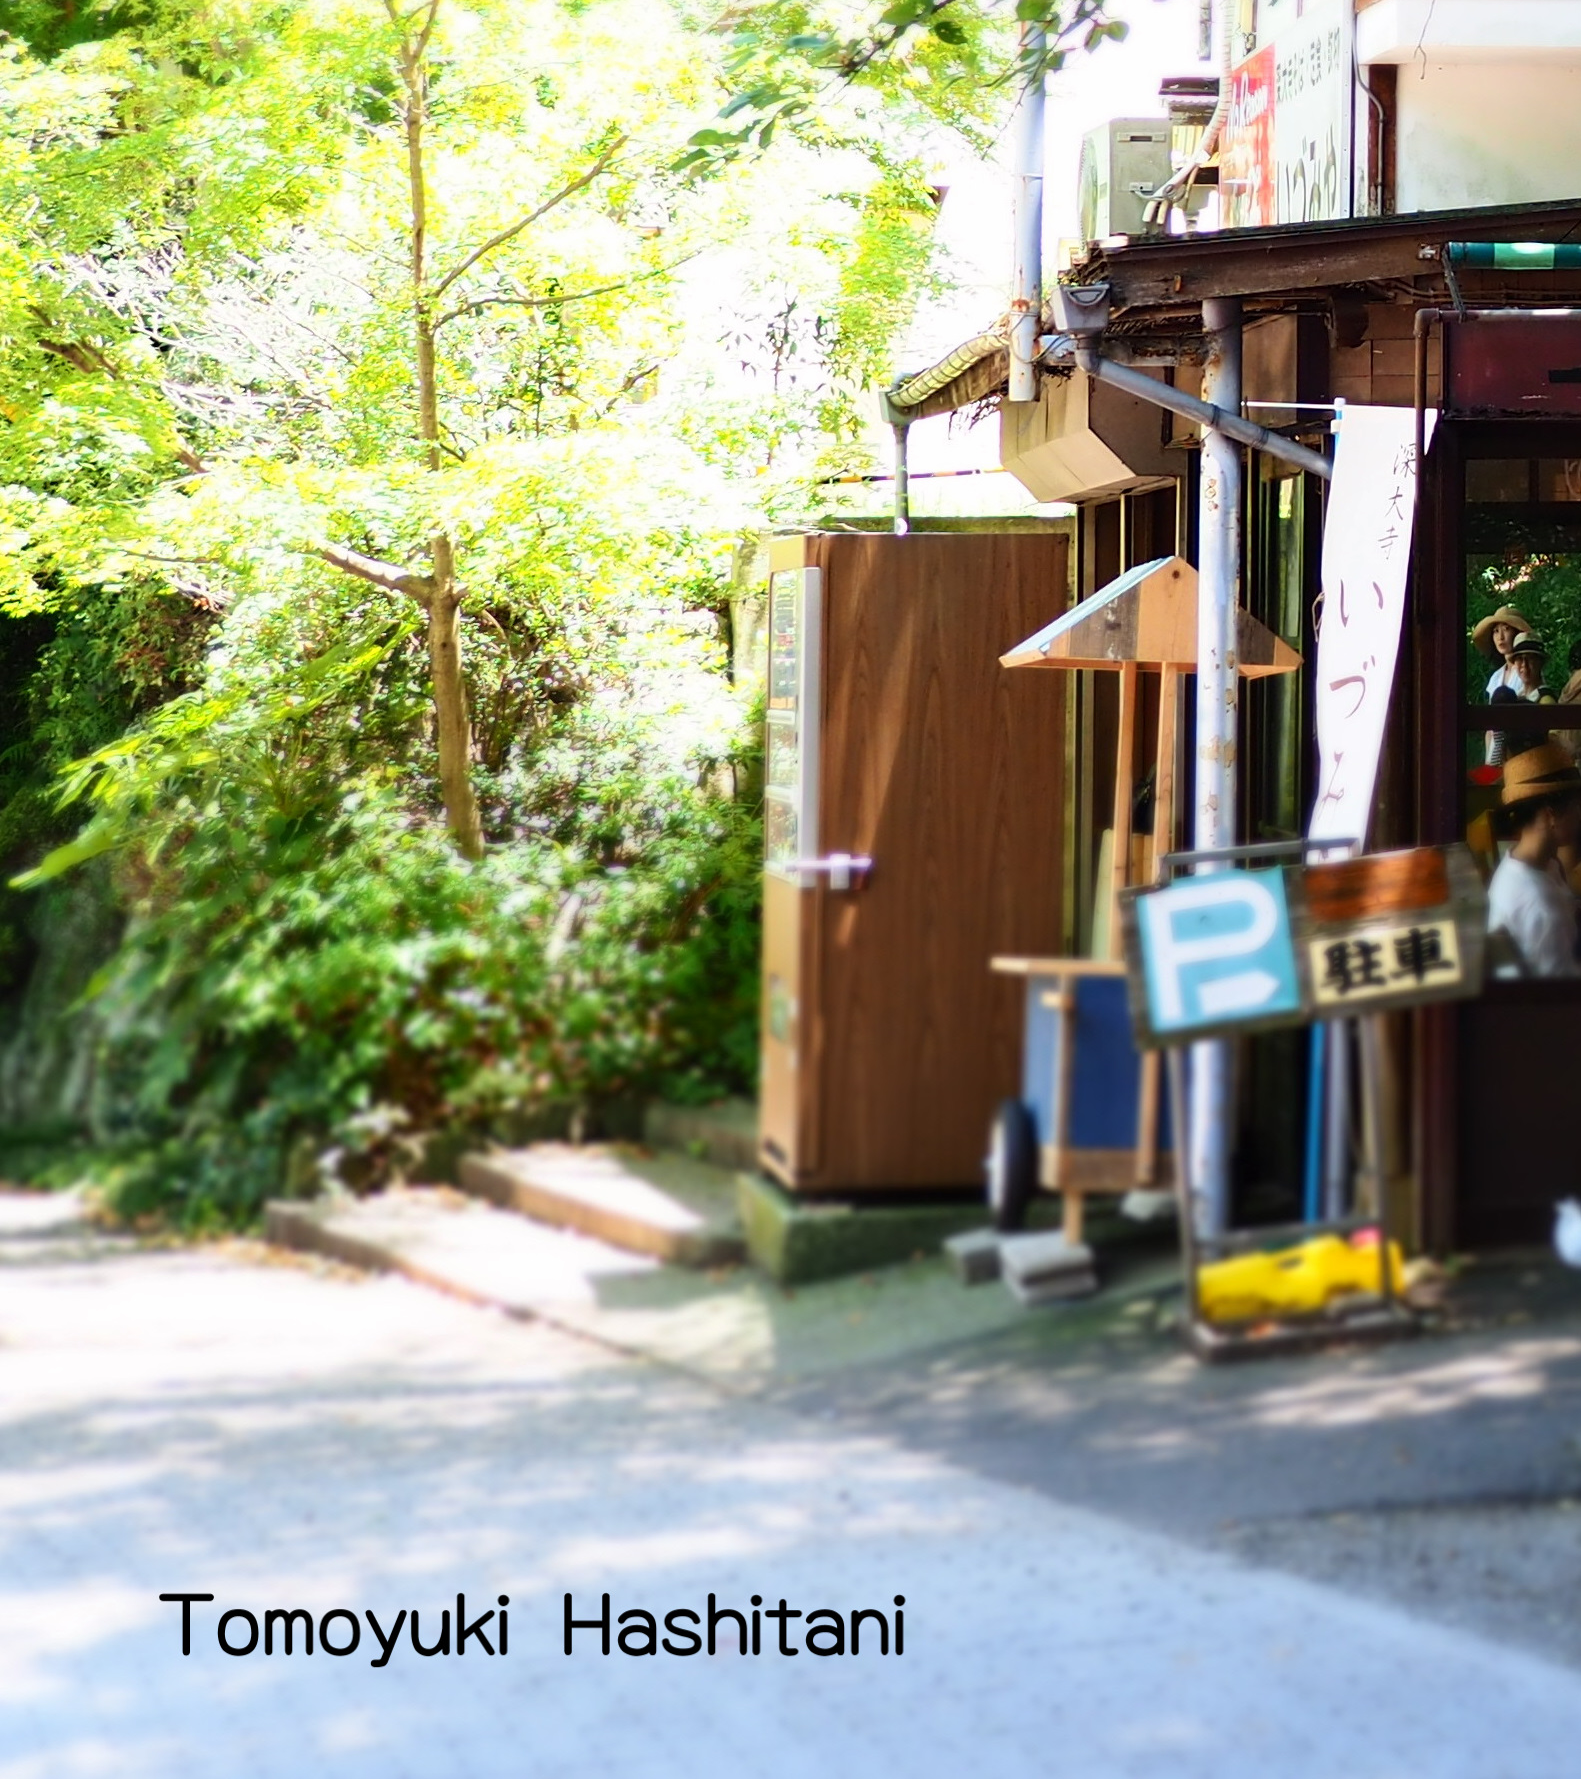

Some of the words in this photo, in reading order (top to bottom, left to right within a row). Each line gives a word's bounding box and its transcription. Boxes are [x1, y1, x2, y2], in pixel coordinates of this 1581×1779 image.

[1377, 442, 1416, 560] 深大寺
[1147, 879, 1278, 1022] P
[1322, 926, 1456, 996] 駐車
